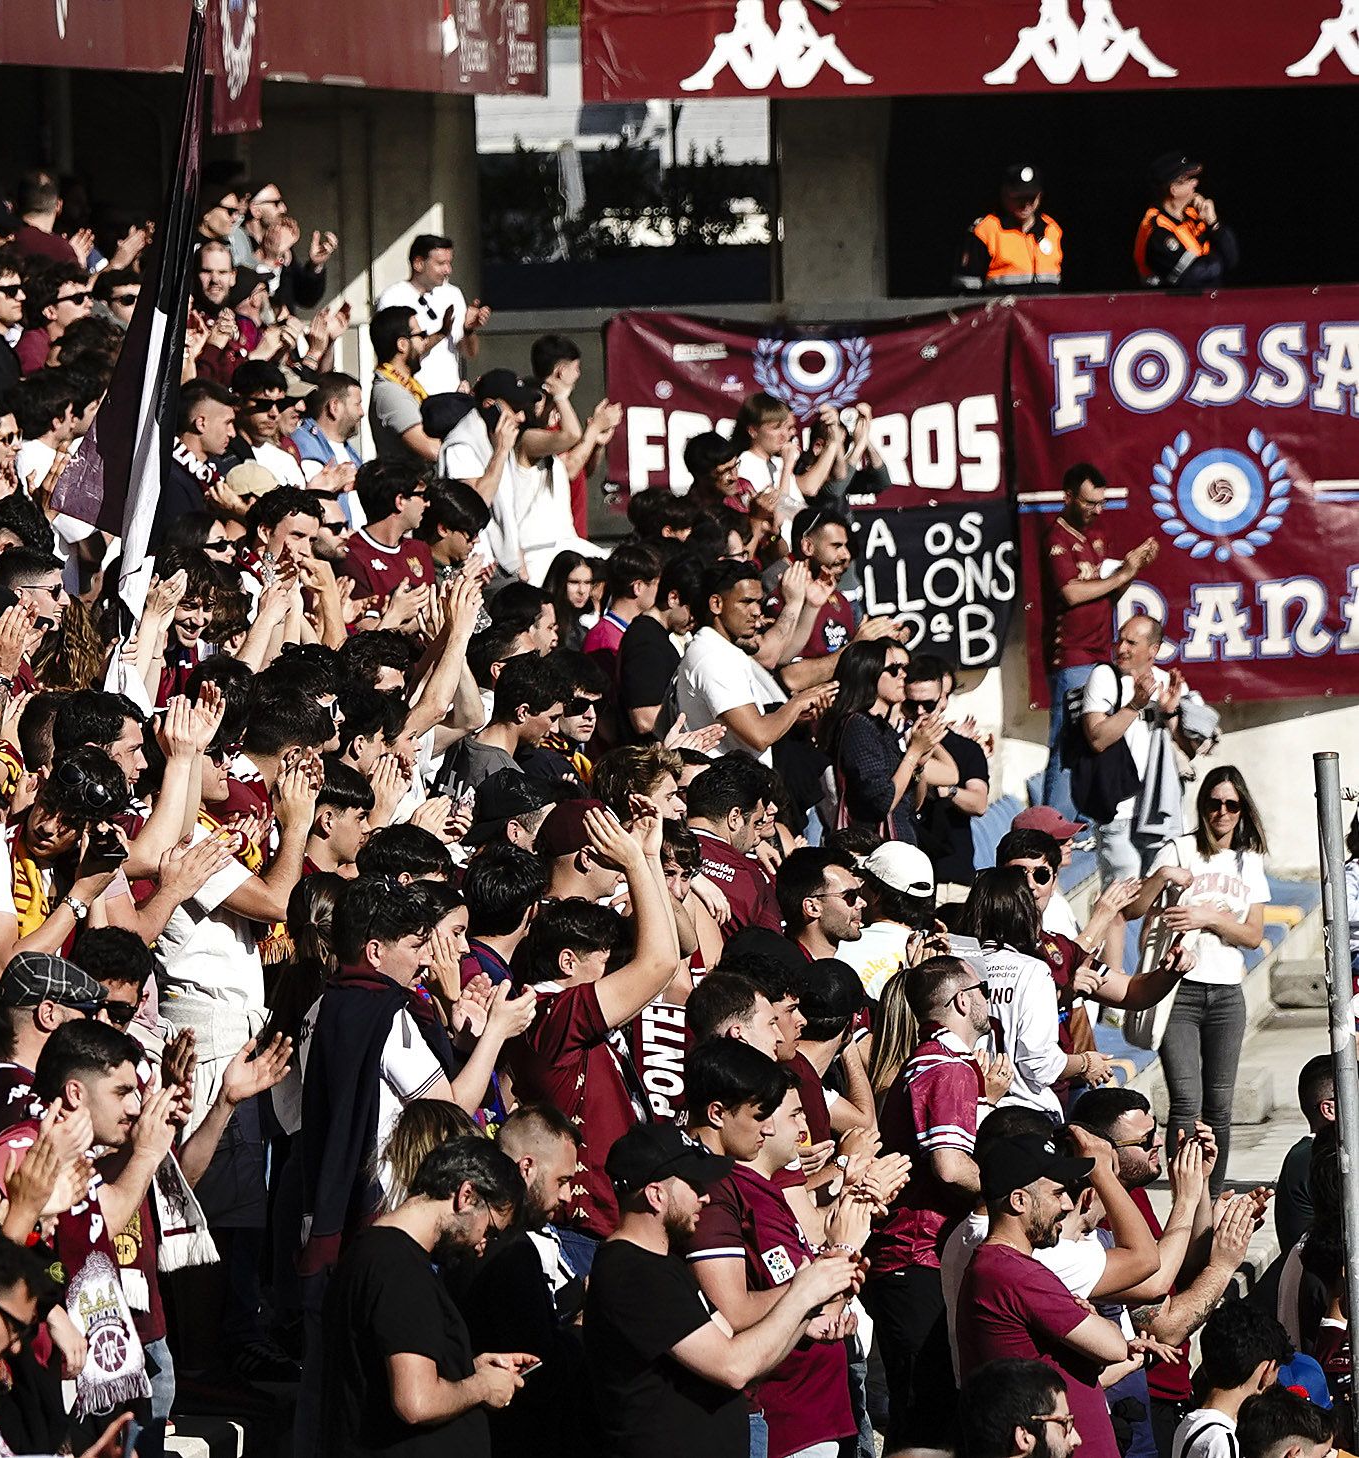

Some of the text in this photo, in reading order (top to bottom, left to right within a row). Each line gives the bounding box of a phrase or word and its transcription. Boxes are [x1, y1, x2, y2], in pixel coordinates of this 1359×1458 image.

[1048, 321, 1359, 436] FOSSA
[924, 511, 984, 556] OS
[862, 540, 1016, 615] LLONS
